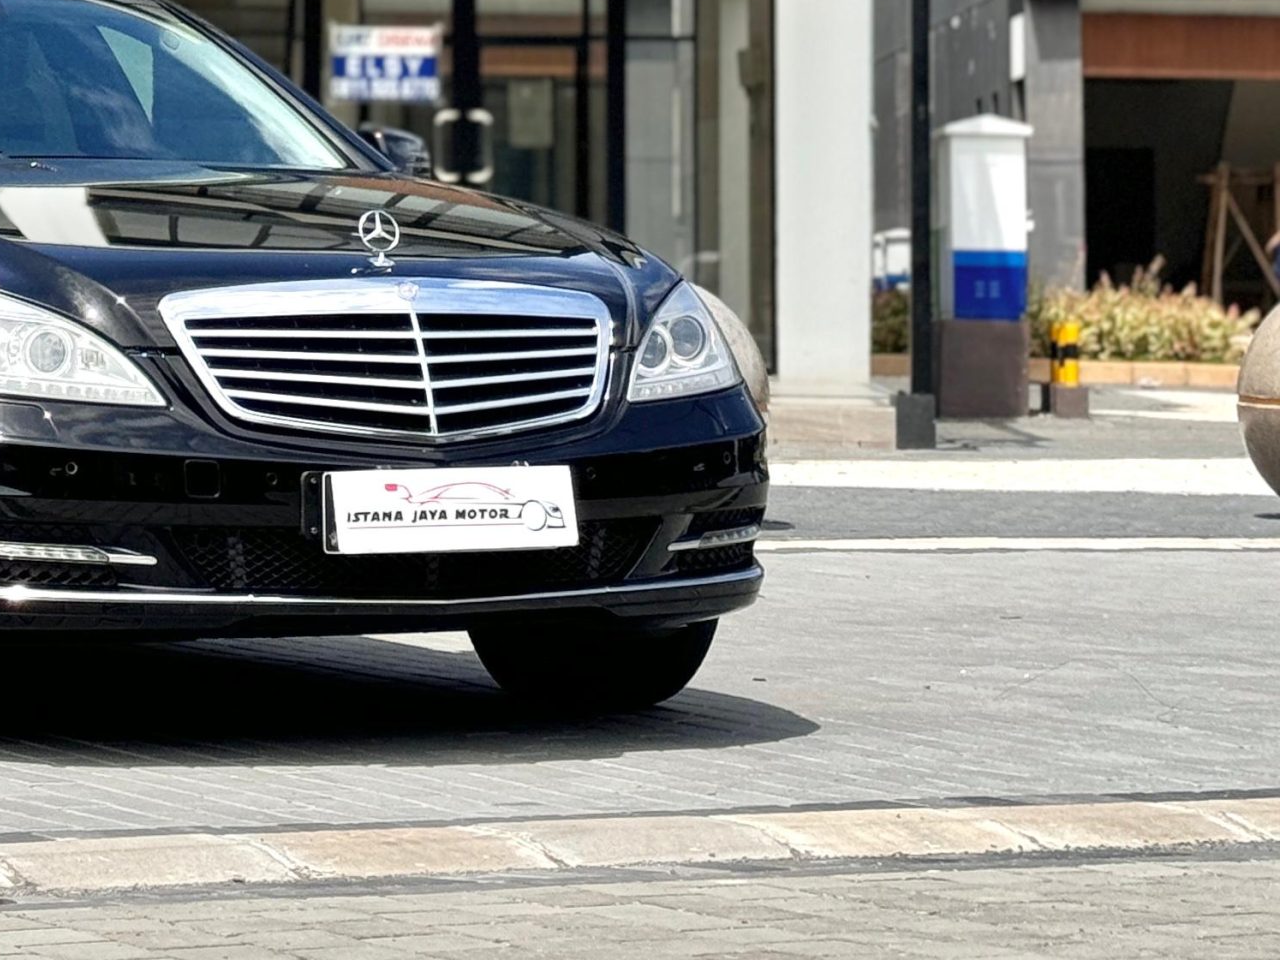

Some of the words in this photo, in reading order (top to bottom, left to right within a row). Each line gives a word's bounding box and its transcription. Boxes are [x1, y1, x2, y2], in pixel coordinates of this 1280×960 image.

[347, 511, 404, 523] ISTANA
[411, 509, 448, 523] JAYA
[455, 508, 509, 520] MOTOR
